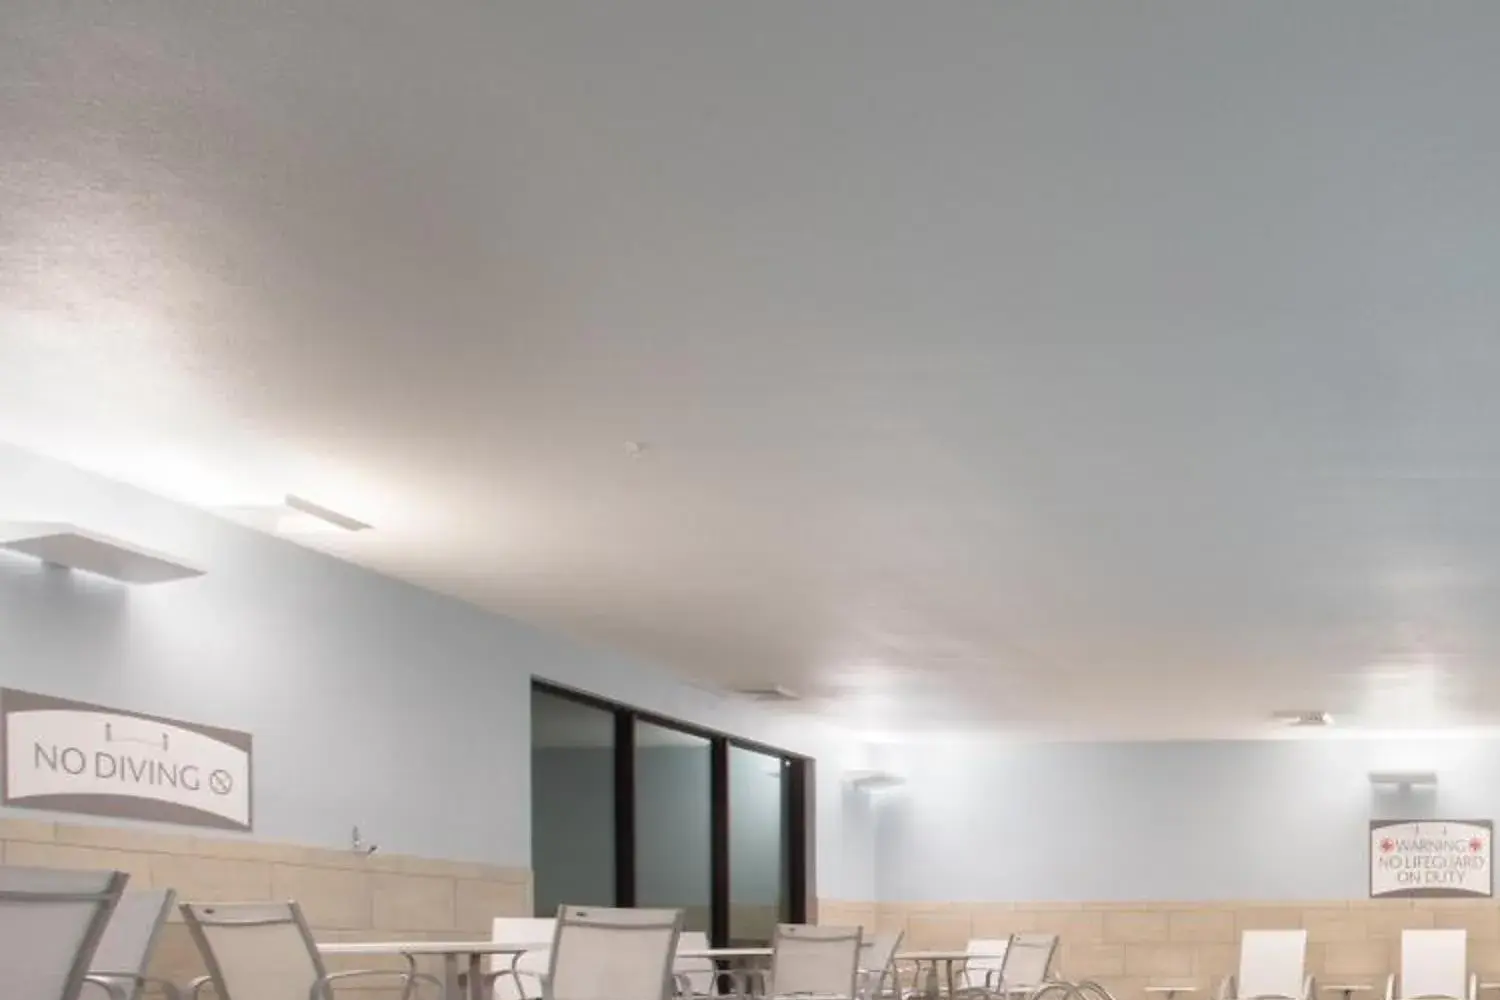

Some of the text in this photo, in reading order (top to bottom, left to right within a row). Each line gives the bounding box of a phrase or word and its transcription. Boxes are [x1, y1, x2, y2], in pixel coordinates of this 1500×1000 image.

[33, 742, 200, 791] NO DIVING
[1396, 839, 1467, 852] WARNING
[1379, 855, 1486, 869] NO LIFEGUARD
[1397, 870, 1465, 883] ON DUTY
